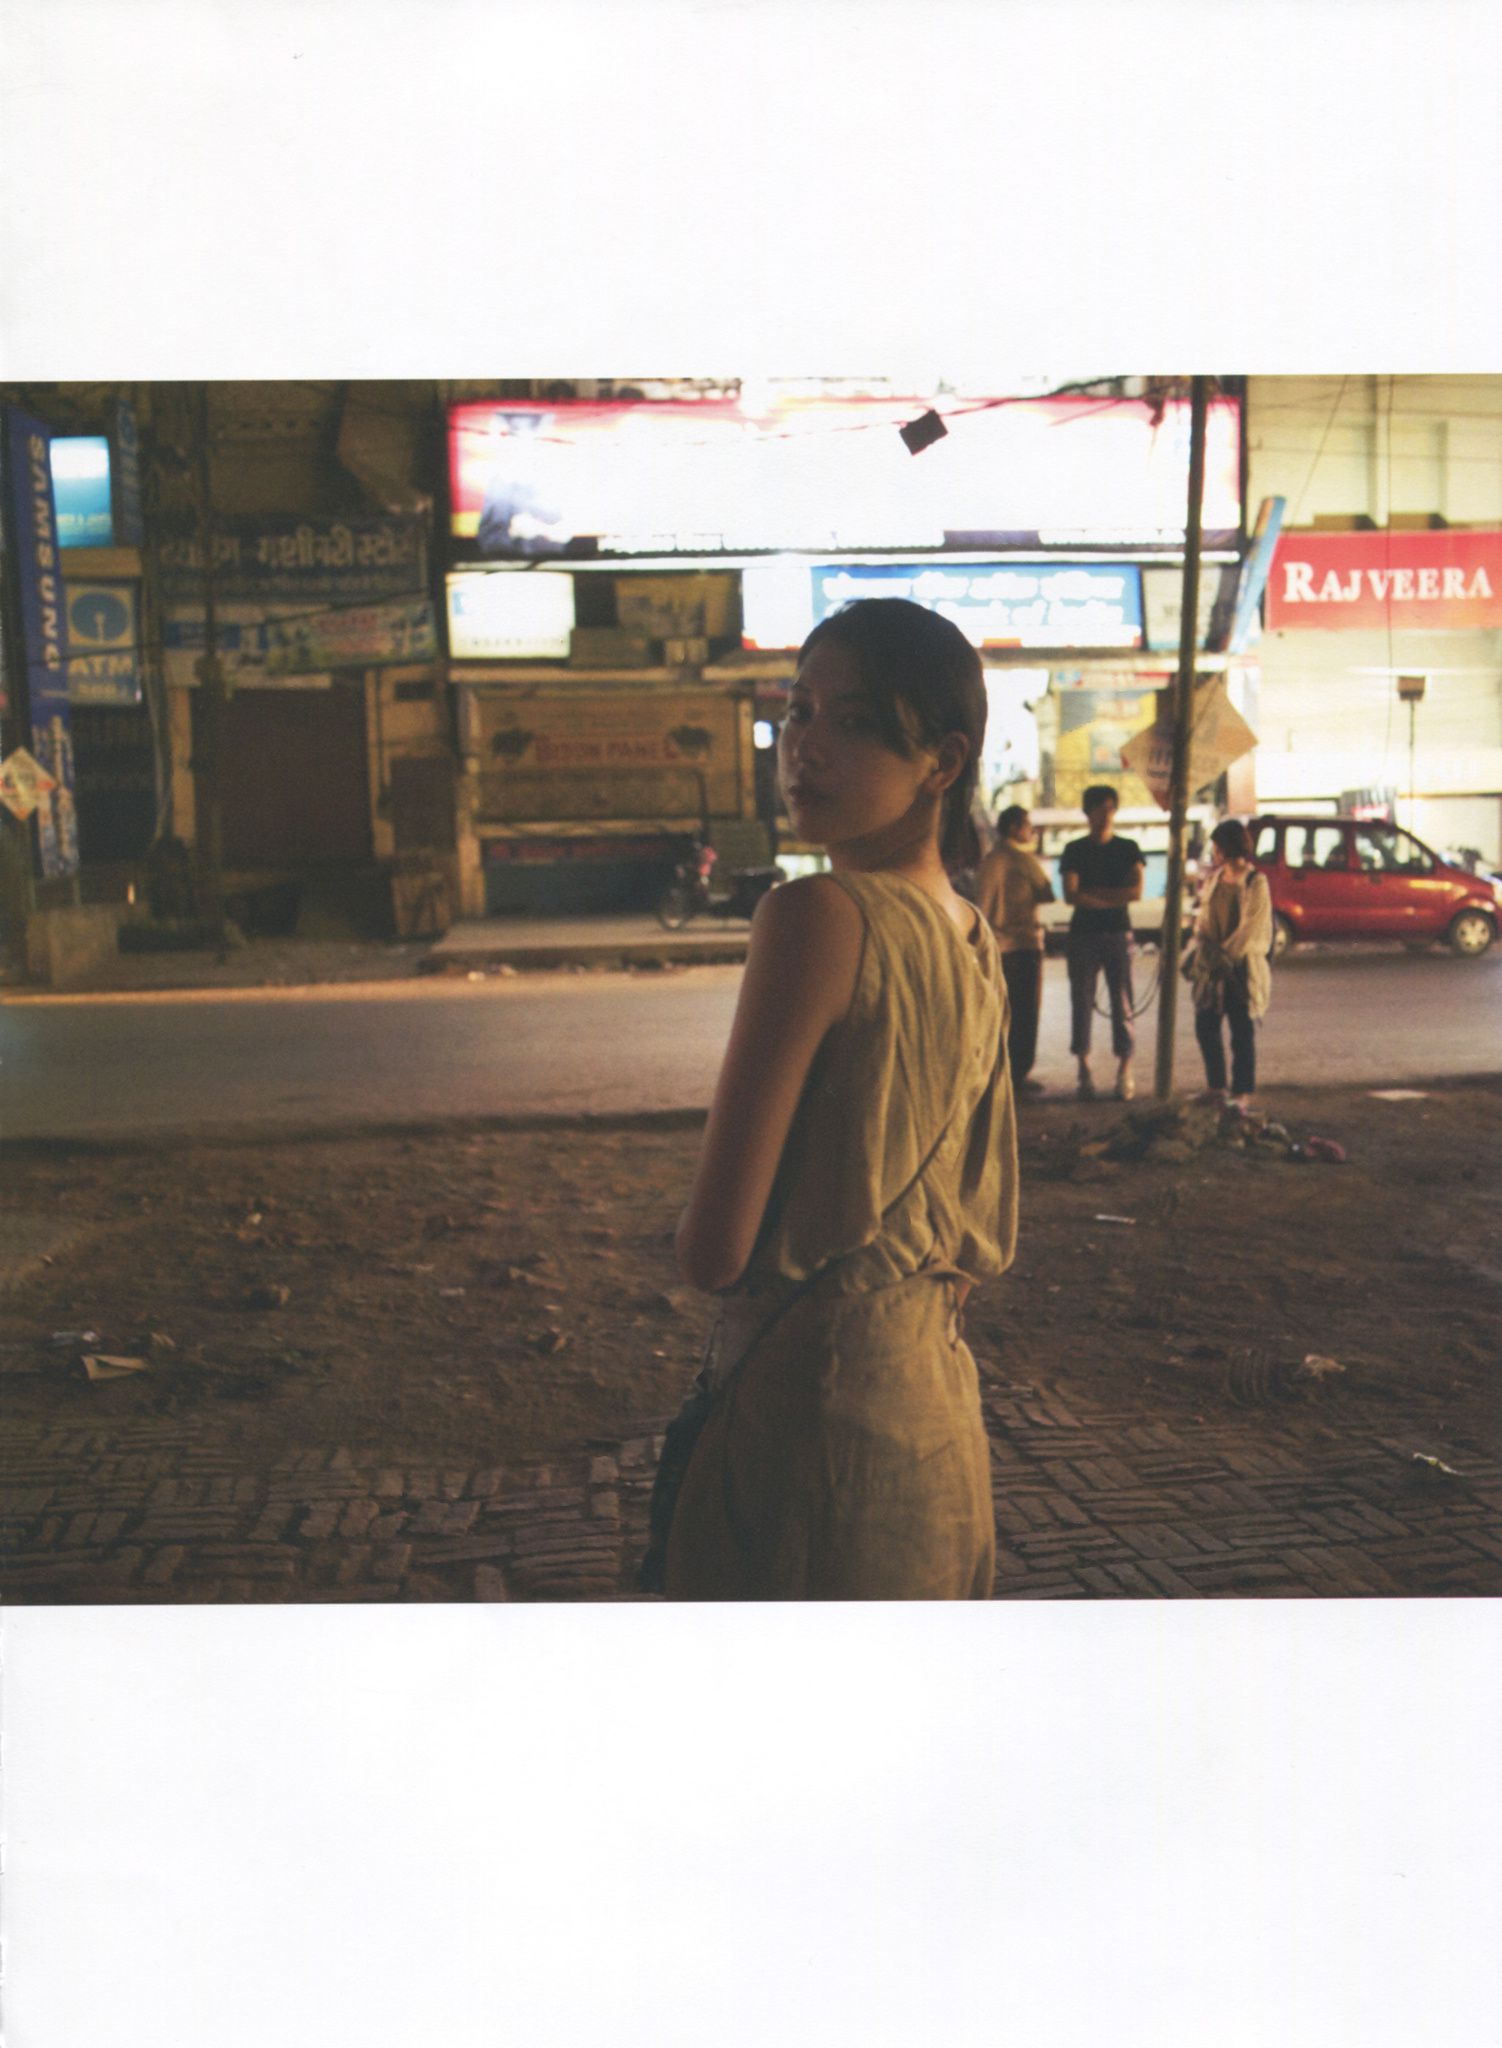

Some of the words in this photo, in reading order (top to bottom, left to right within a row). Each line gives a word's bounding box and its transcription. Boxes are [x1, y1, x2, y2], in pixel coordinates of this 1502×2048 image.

[28, 434, 60, 670] SAMSUNG
[1283, 562, 1493, 602] RAJVEERA
[67, 654, 133, 677] ATM
